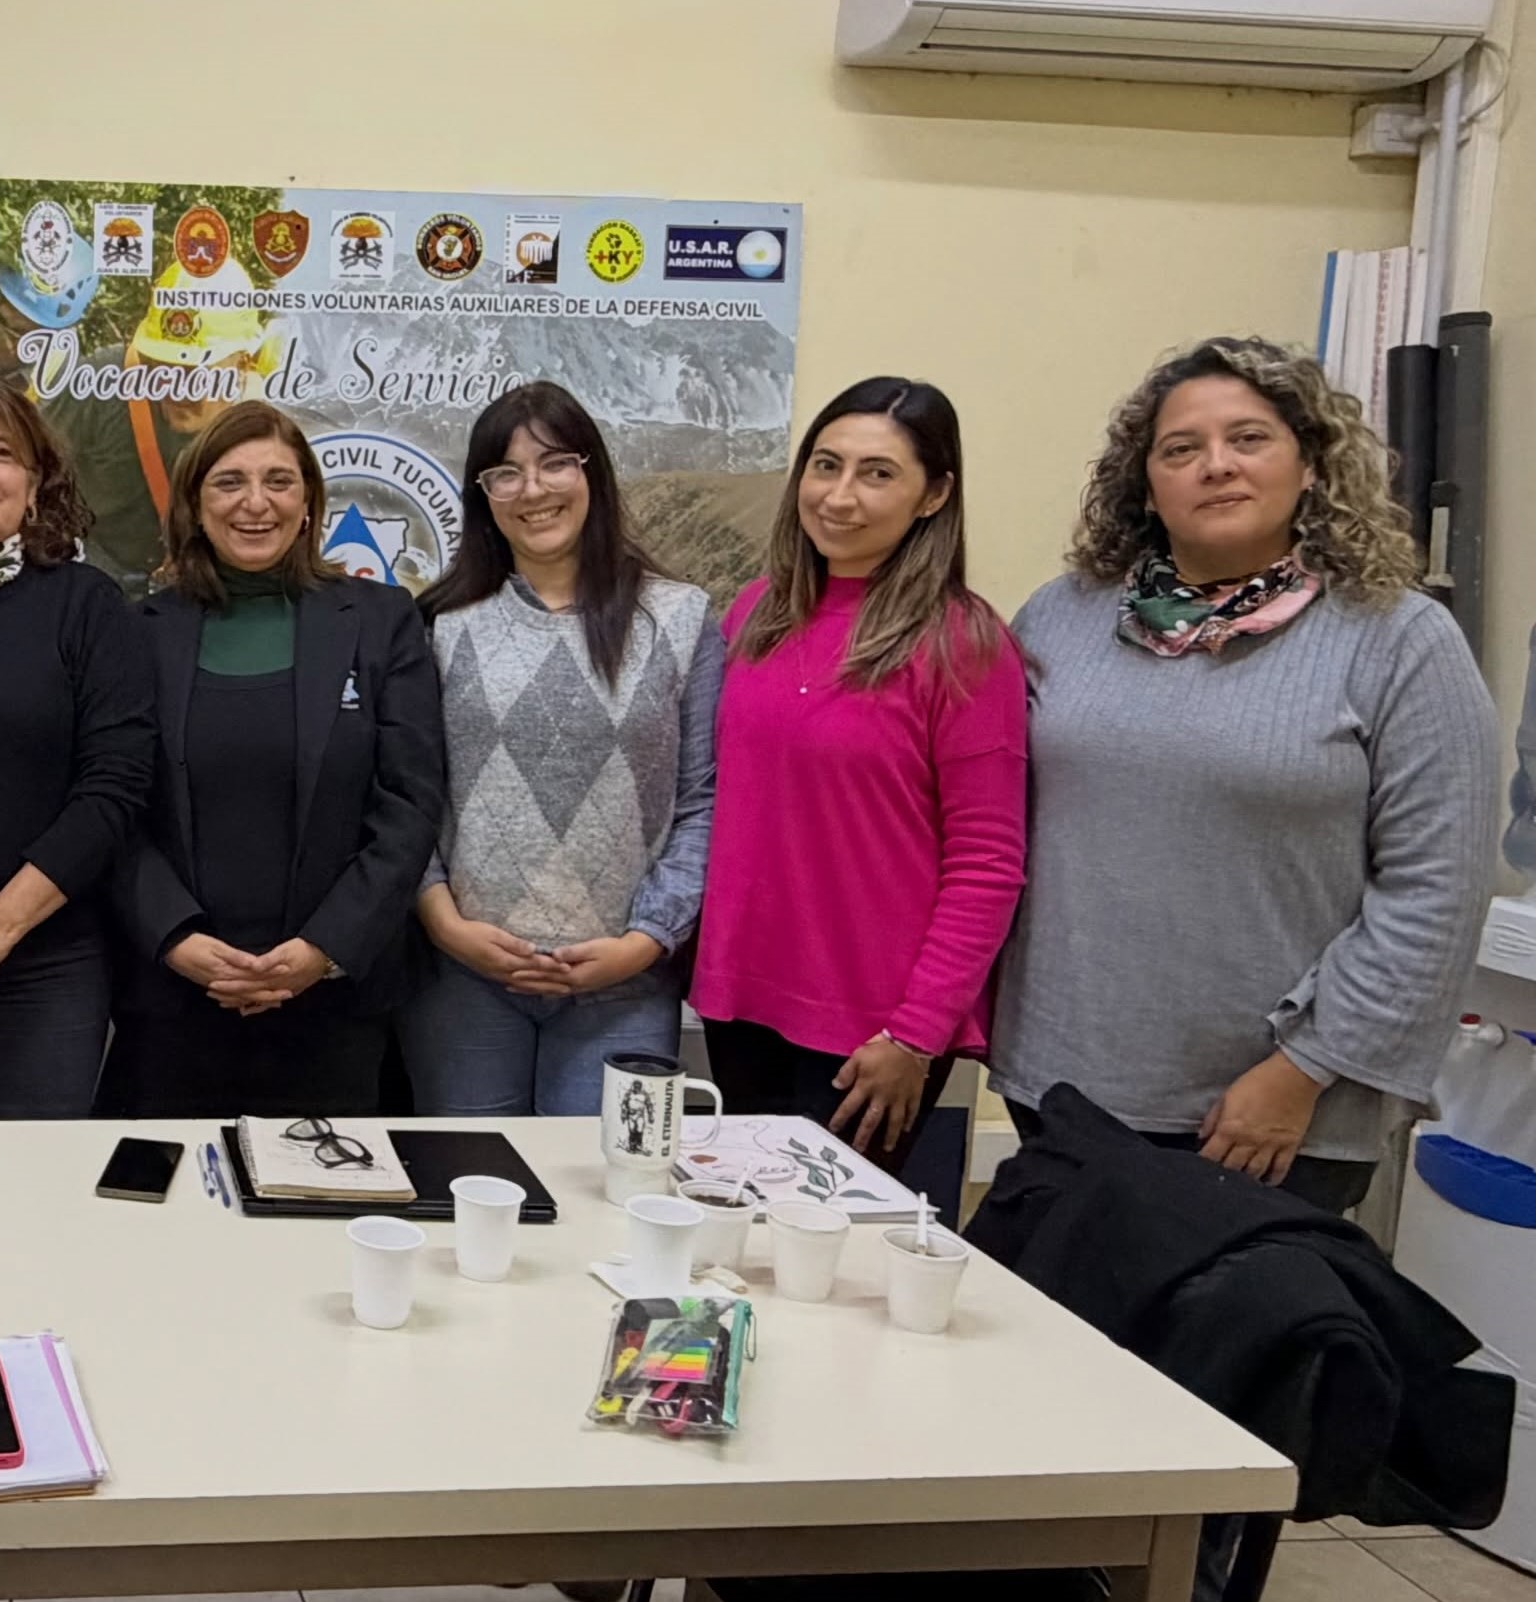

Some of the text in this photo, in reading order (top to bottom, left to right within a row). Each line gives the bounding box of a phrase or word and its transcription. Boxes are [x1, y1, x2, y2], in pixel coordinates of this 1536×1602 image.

[668, 239, 734, 256] U.S.A.R.
[667, 258, 733, 269] ARGENTINA
[156, 290, 763, 318] INSTITUCIONES VOLUNTARIAS AUXILIARES DE LA DEFENSA CIVIL
[19, 329, 238, 401] Vocación
[265, 336, 313, 399] de
[322, 447, 383, 469] CIVIL
[661, 1079, 674, 1157] EL ETERNAUTA
